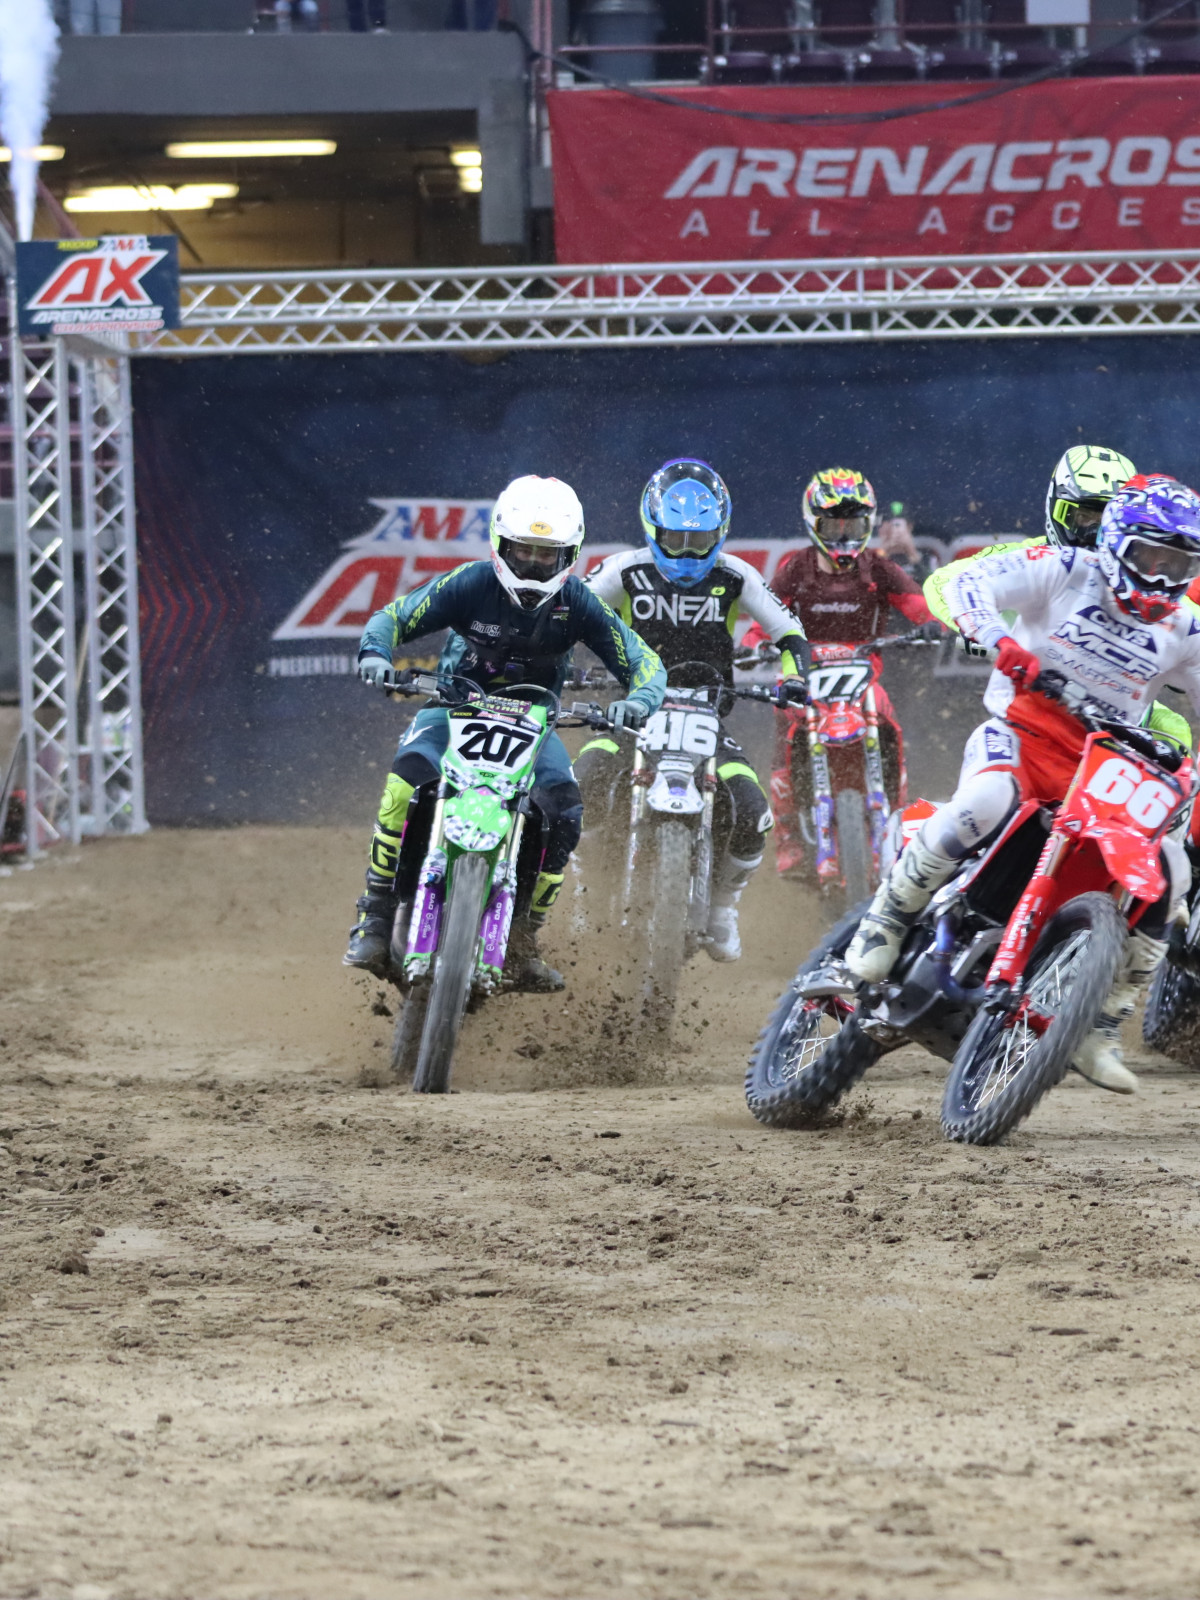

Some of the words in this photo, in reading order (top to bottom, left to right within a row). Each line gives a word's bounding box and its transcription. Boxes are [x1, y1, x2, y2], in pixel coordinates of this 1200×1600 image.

[680, 206, 832, 239] ALL
[37, 254, 157, 304] AX
[32, 307, 164, 325] ARENACROSS
[457, 722, 536, 768] 207
[643, 710, 720, 757] 416
[1086, 757, 1178, 829] 66
